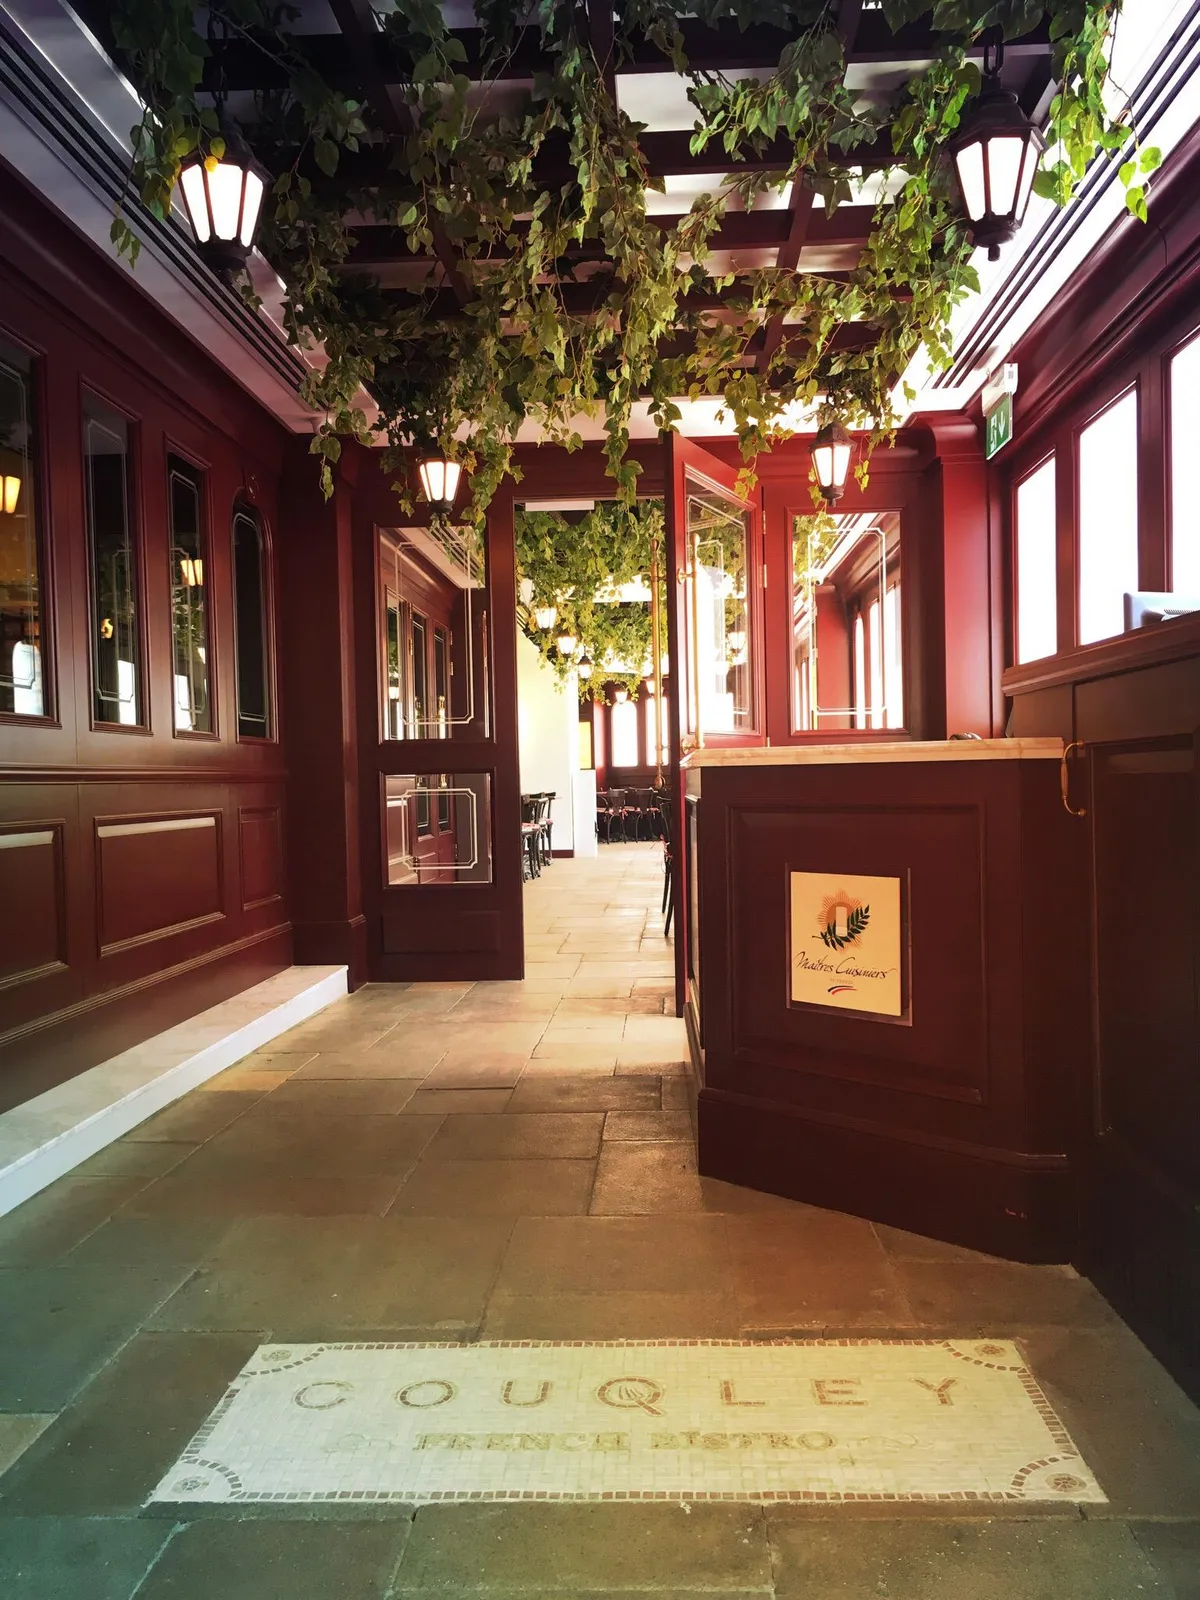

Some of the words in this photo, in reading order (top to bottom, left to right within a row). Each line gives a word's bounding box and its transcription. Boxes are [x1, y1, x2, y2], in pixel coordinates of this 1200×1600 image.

[835, 957, 897, 980] Cuisiniers
[294, 1376, 958, 1416] COUQLEY
[412, 1432, 631, 1451] FRENCH
[651, 1431, 836, 1451] BISTRO
